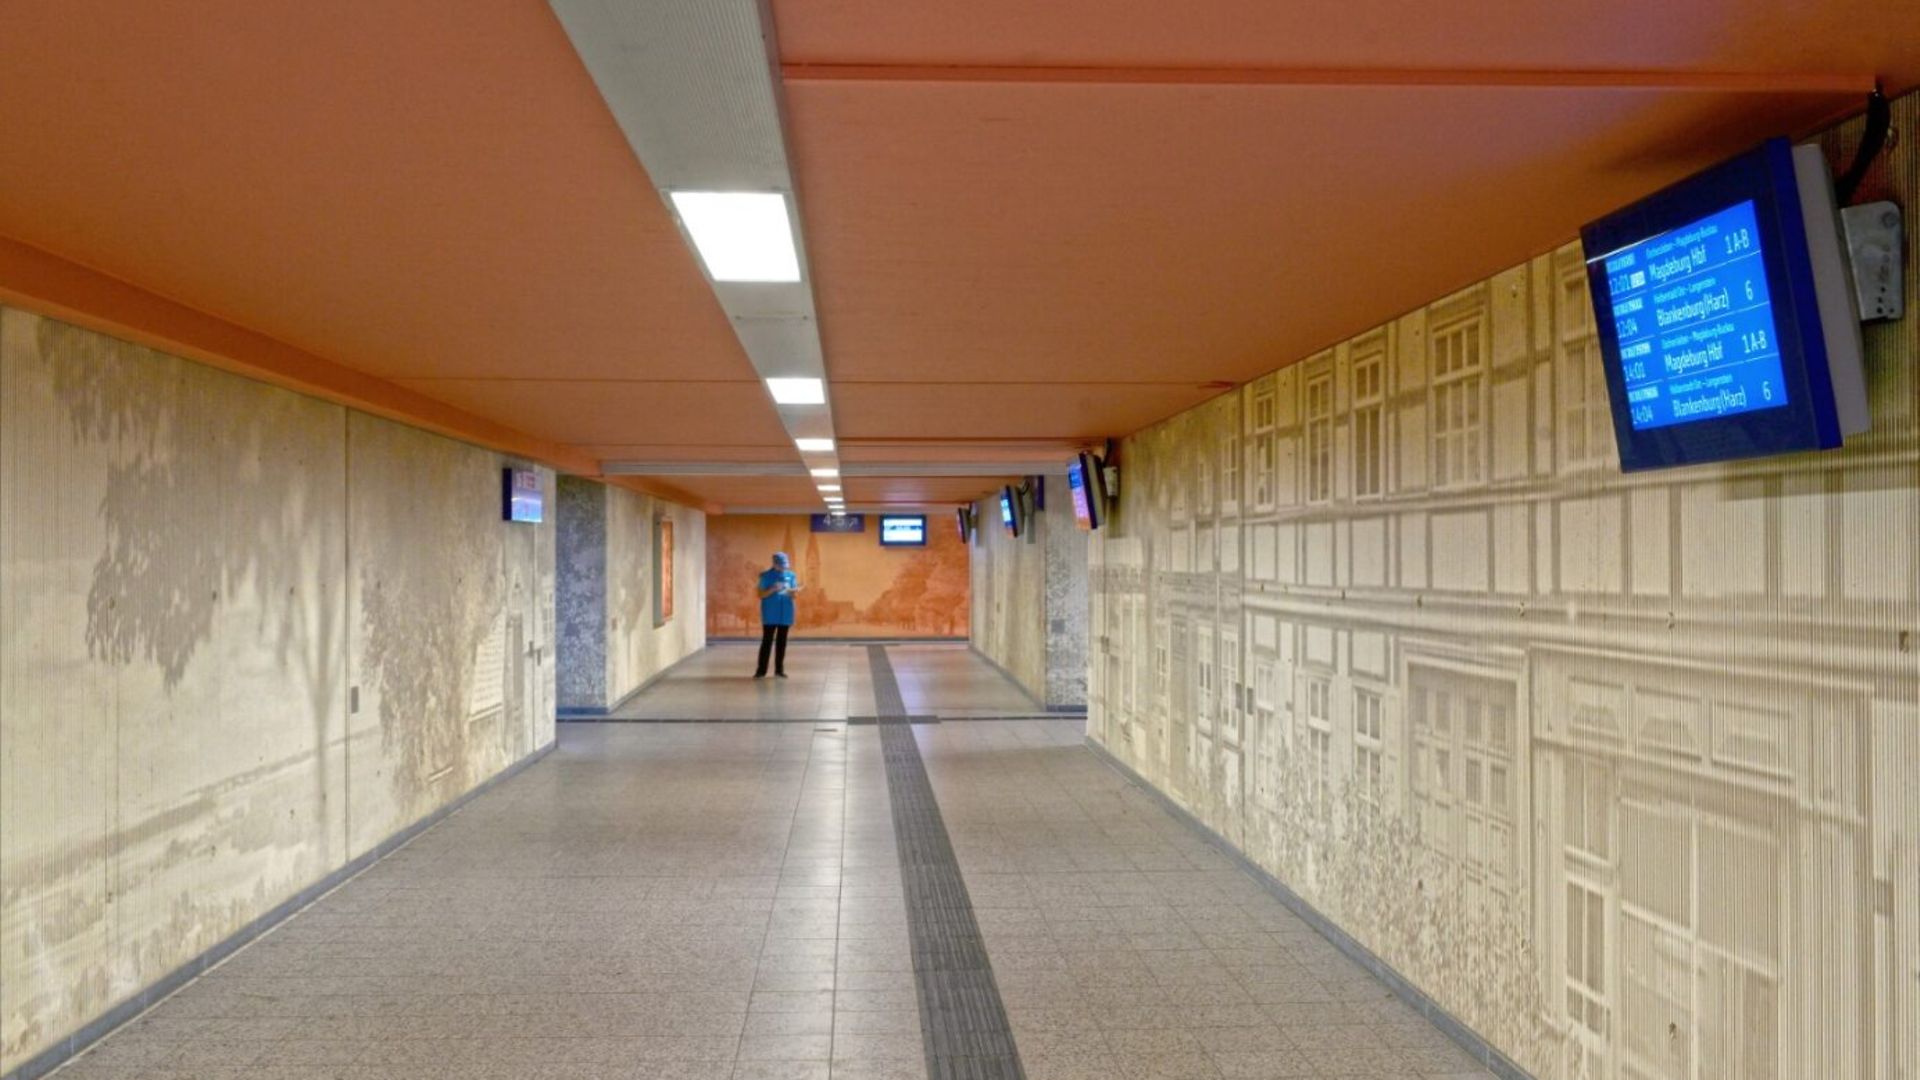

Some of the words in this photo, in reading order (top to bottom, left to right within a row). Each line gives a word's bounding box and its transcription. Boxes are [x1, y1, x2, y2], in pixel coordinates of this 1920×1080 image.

[1725, 235, 1733, 254] 1
[1733, 228, 1749, 252] A-B
[1649, 255, 1691, 281] Magdeburg
[1691, 244, 1706, 266] Hbf
[1745, 279, 1753, 300] 6
[1742, 333, 1751, 353] 1
[1750, 329, 1766, 351] A-B
[1664, 348, 1708, 374] Magdeburg
[1707, 340, 1723, 361] Hbf
[1762, 380, 1771, 400] 6
